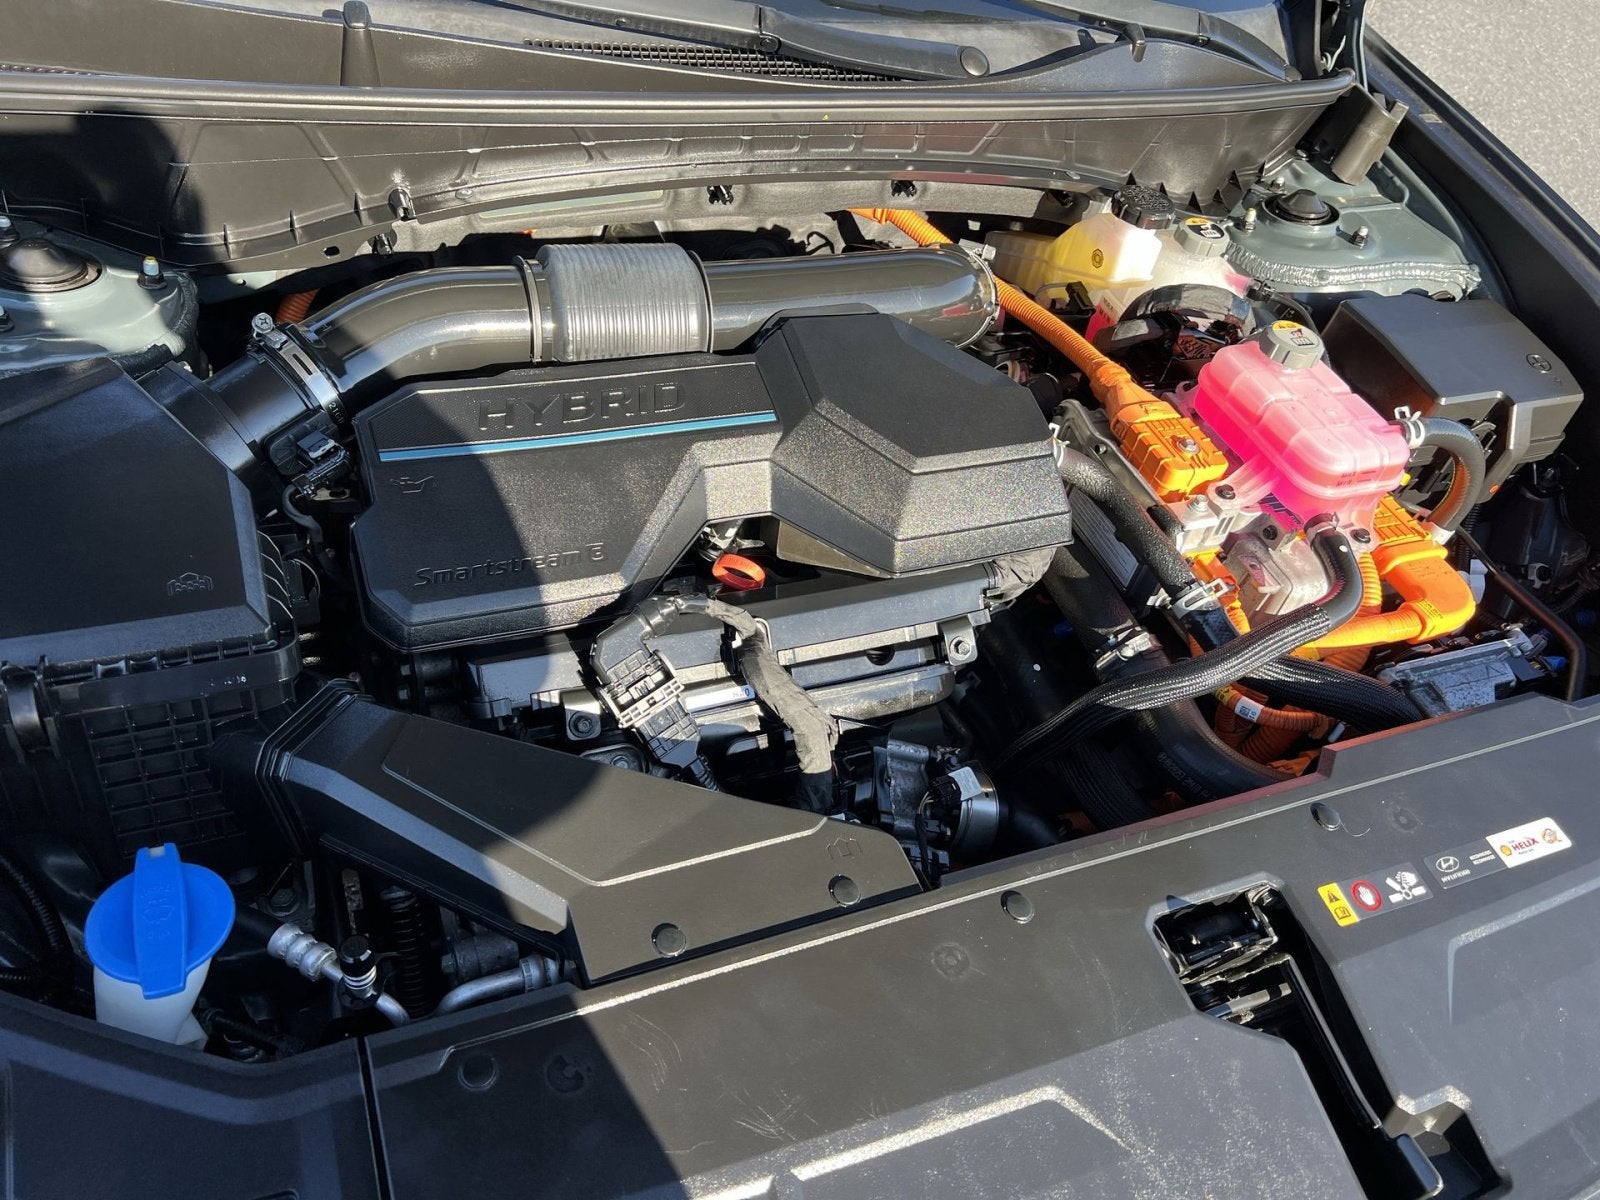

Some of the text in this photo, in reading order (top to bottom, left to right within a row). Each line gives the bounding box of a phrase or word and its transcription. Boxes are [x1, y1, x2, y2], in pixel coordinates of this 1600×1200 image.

[478, 382, 686, 431] HYBRID
[413, 549, 581, 587] Smartstream
[1511, 837, 1540, 852] HELIX
